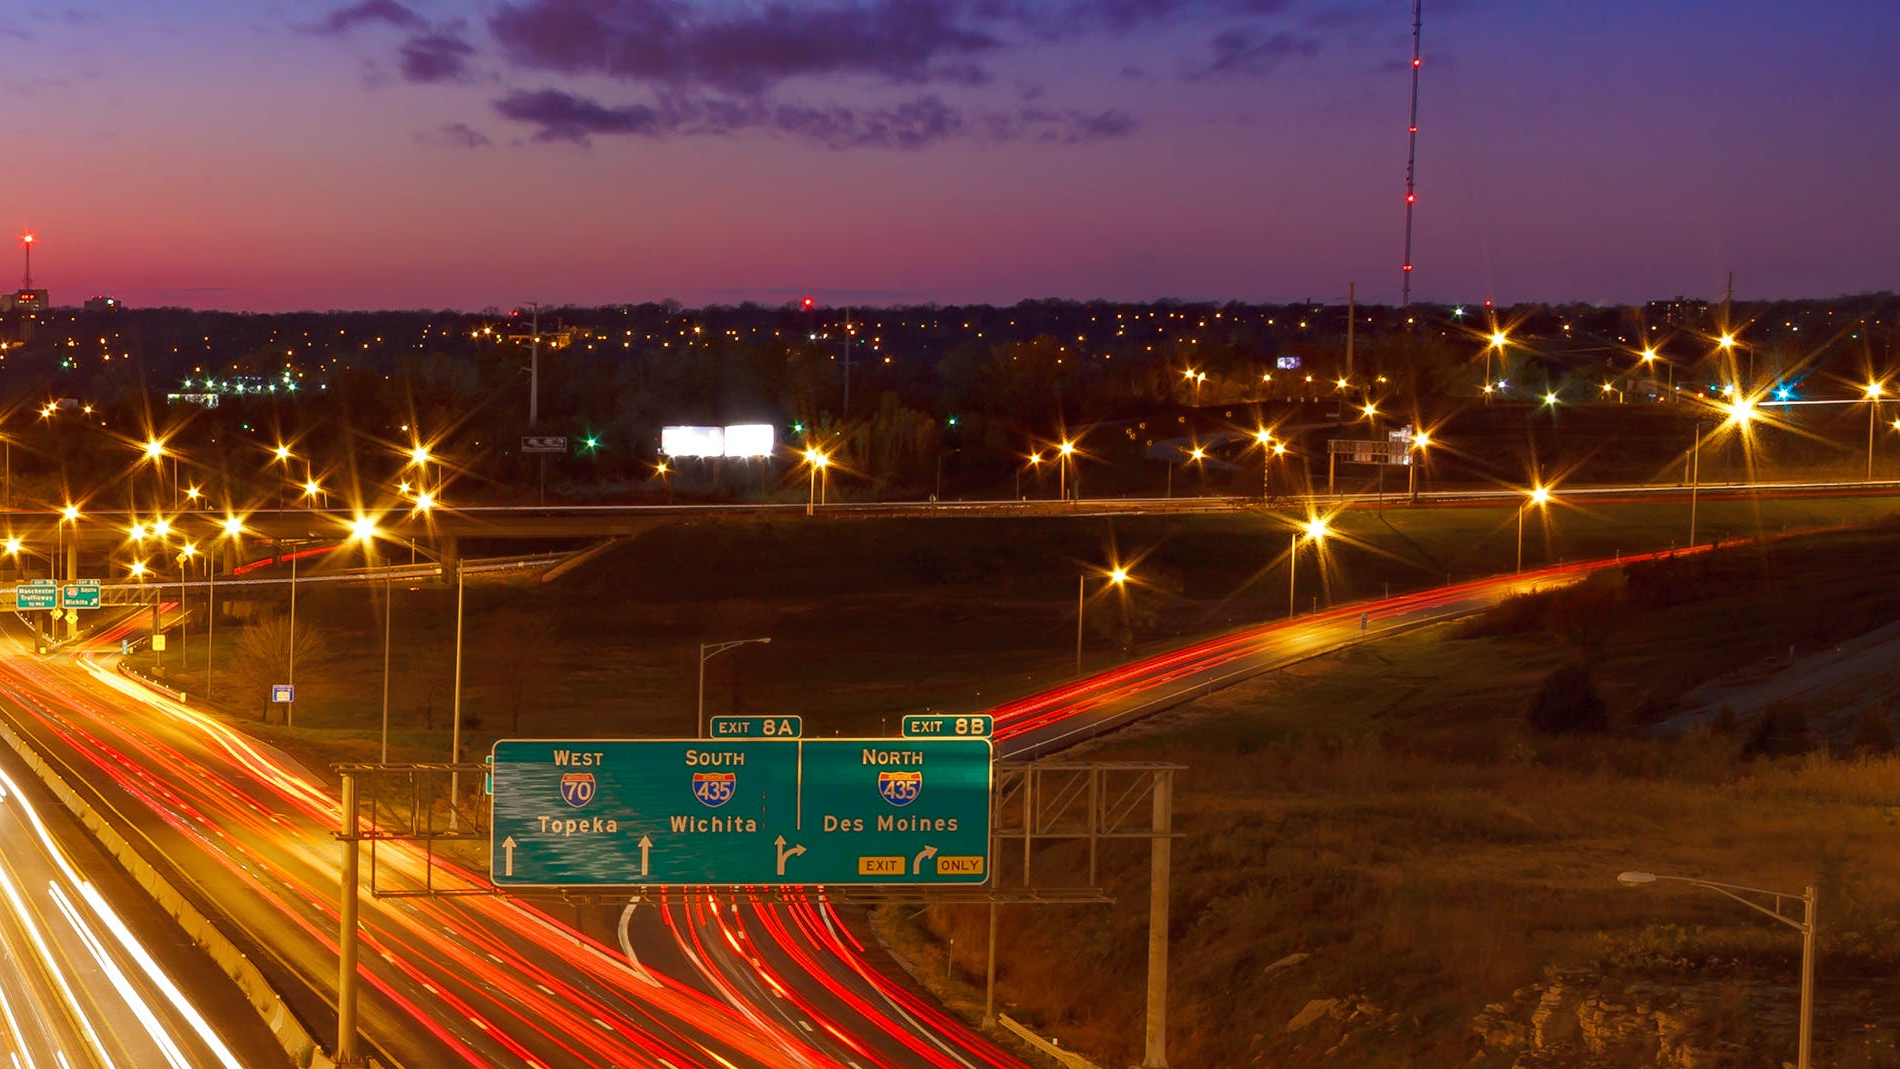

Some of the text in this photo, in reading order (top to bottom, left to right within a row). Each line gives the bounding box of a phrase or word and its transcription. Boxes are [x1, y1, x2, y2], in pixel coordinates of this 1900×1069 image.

[718, 719, 793, 736] EXIT 8A
[911, 718, 984, 735] EXIT 8B
[553, 750, 604, 766] WEST
[685, 749, 745, 766] SOUTH
[862, 749, 923, 765] NORTH
[564, 781, 592, 801] 70
[697, 781, 731, 800] 435
[883, 780, 917, 800] 435
[537, 815, 618, 837] Topeka
[670, 816, 757, 832] Wichita
[823, 815, 958, 832] Des Moines
[866, 860, 979, 871] EXIT ONLY
